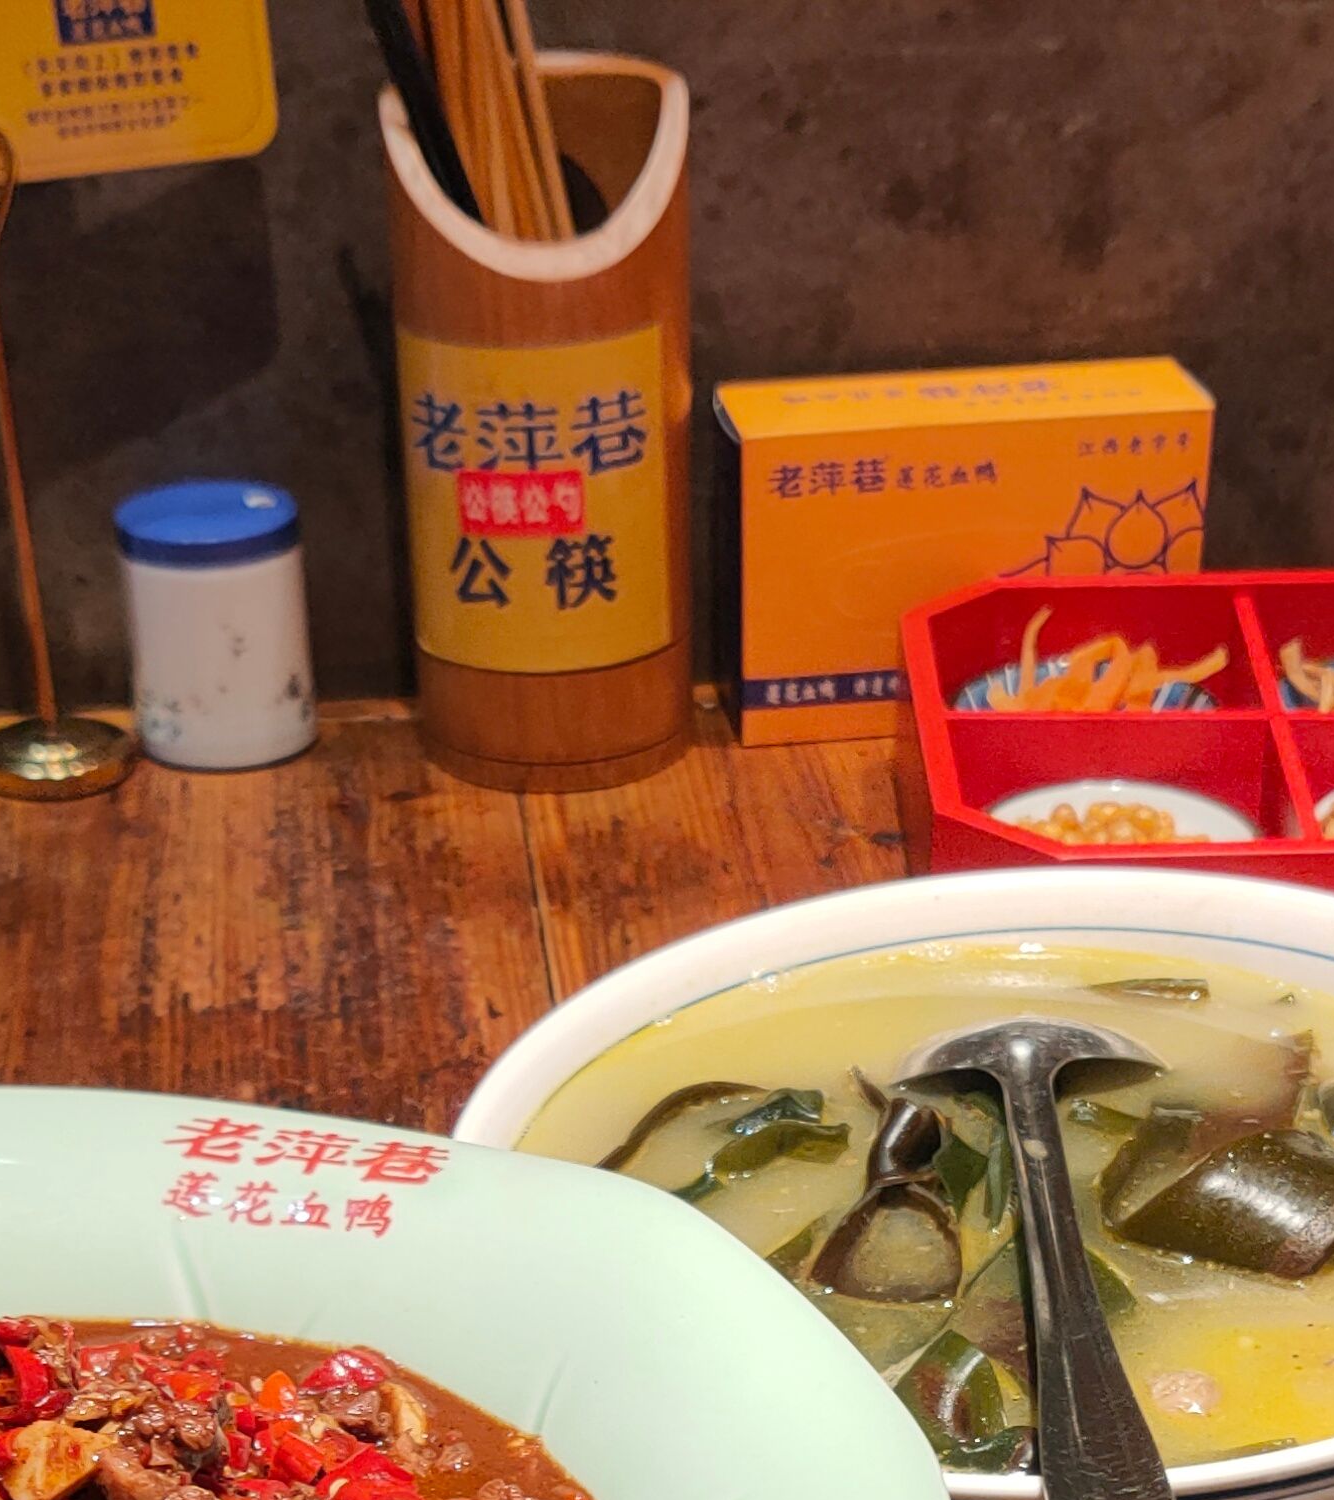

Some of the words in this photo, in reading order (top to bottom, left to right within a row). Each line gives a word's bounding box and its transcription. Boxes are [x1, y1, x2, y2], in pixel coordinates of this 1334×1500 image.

[411, 390, 647, 475] 老萍巷
[767, 458, 887, 499] 老萍巷
[449, 533, 618, 610] 公筷
[163, 1117, 450, 1186] 老萍巷
[162, 1170, 394, 1238] 莲花血鸭
